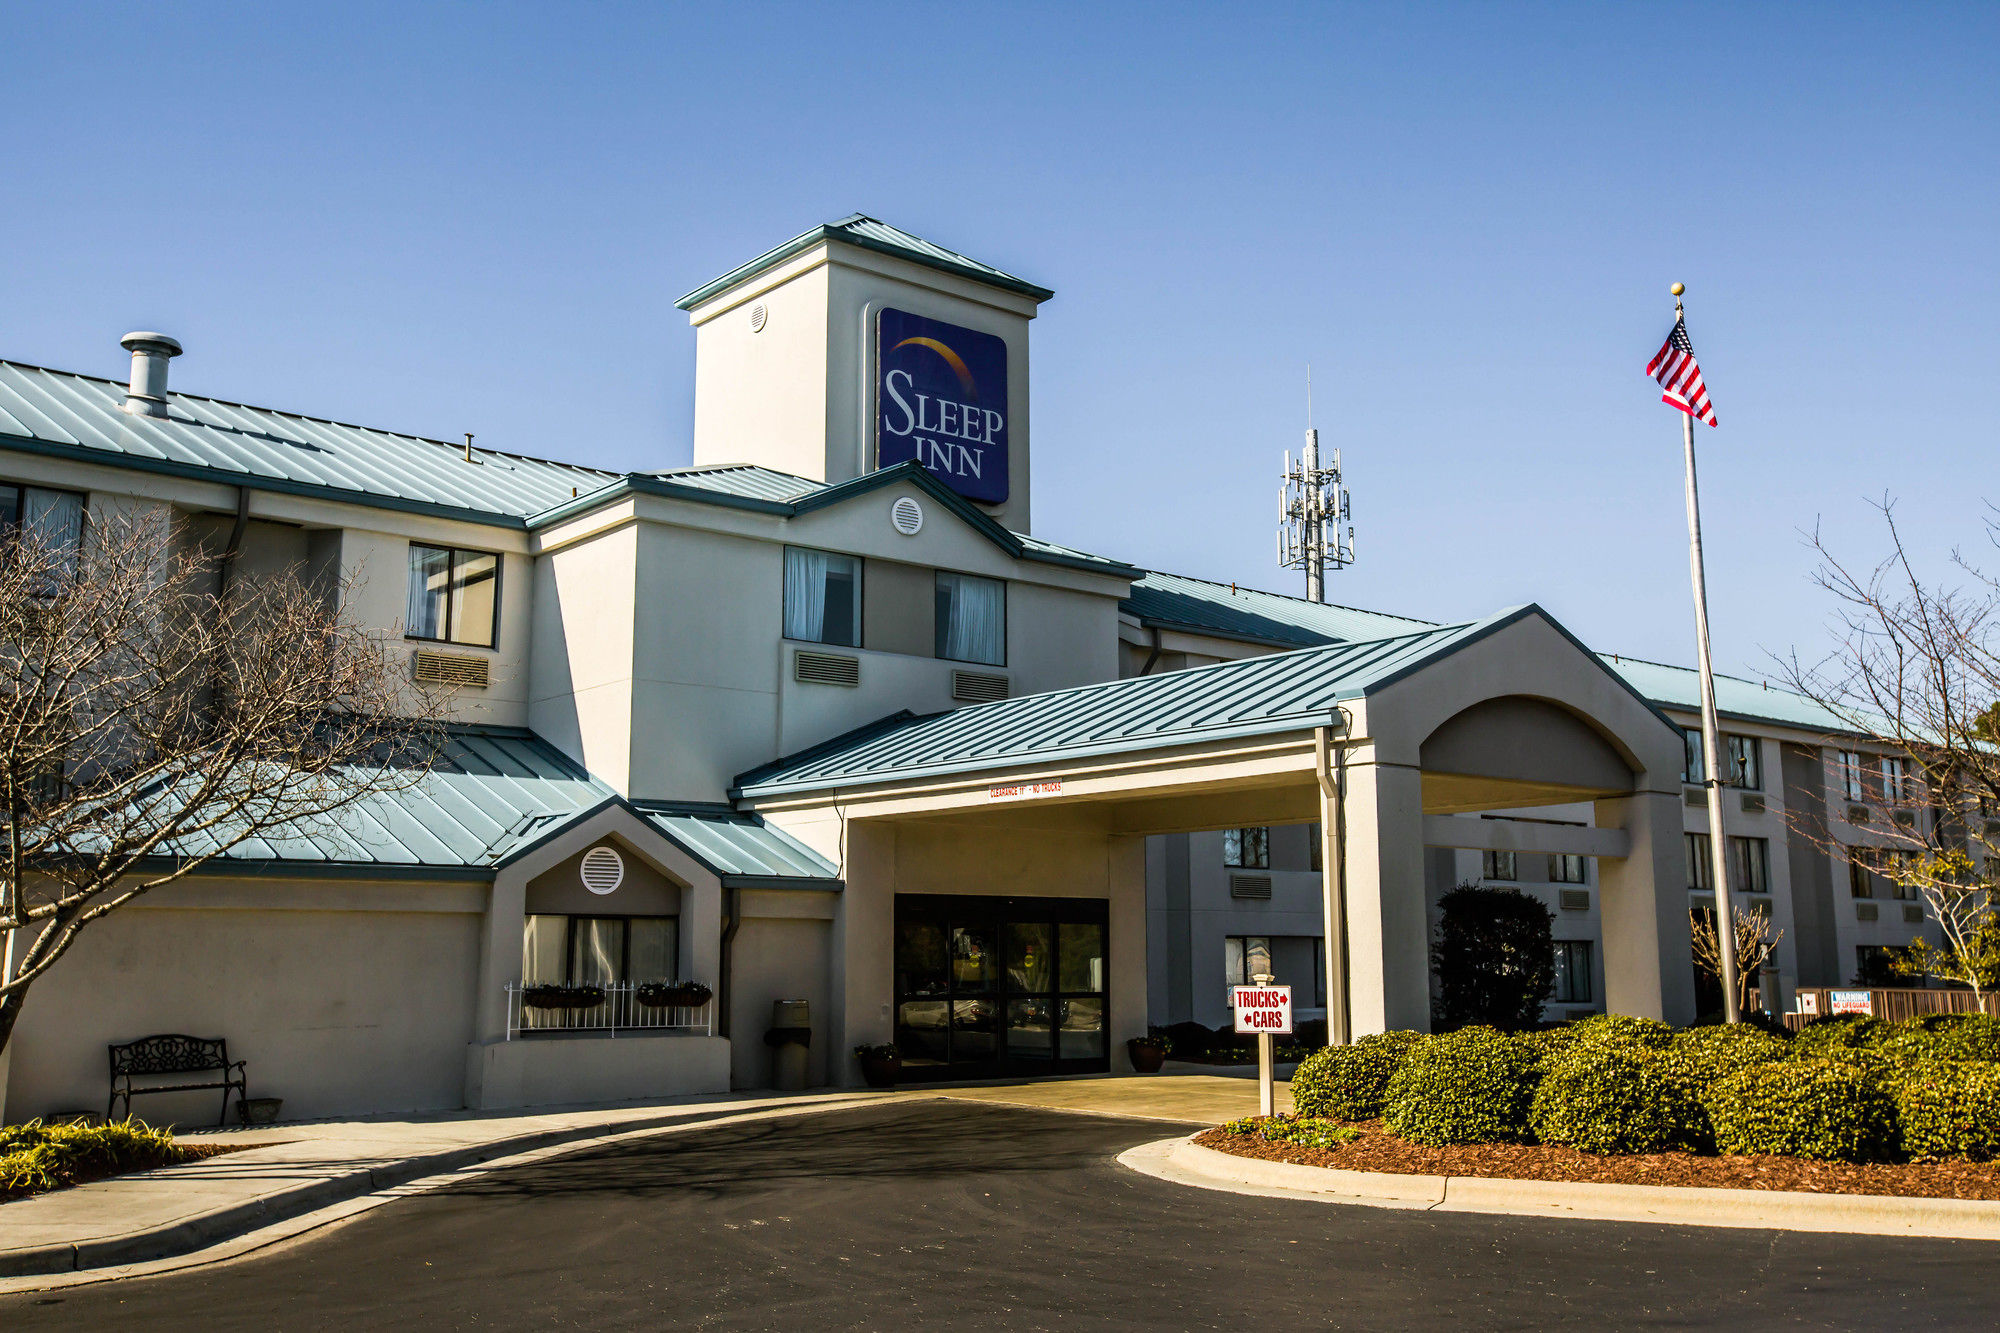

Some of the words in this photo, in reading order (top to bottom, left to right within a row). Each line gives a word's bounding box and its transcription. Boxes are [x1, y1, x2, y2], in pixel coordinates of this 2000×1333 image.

[885, 369, 1003, 445] SLEEP
[913, 436, 984, 480] INN
[990, 786, 1018, 798] CLEARANCE
[1033, 784, 1040, 793] NO
[1041, 782, 1061, 792] TRUCKS
[1237, 991, 1279, 1008] TRUCKS
[1834, 992, 1867, 1002] WARNING
[1842, 1001, 1869, 1009] LIFEGUARD
[1253, 1011, 1282, 1028] CARS
